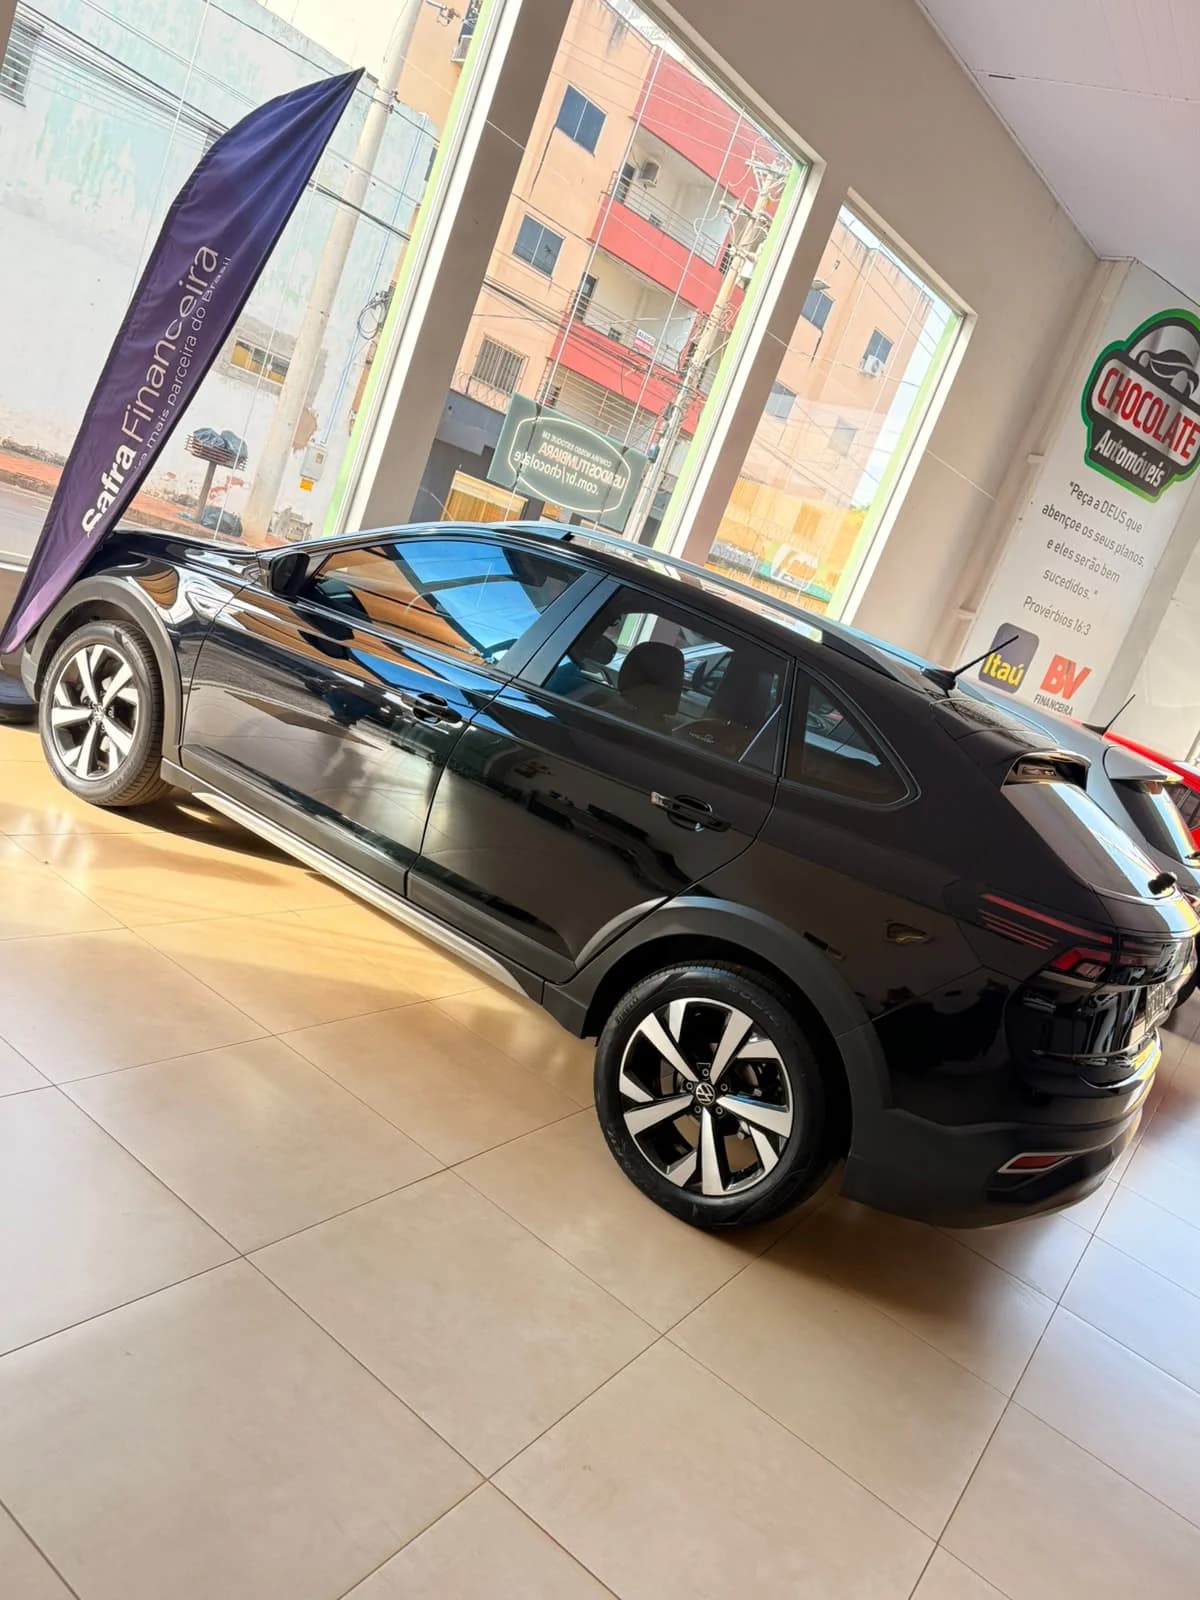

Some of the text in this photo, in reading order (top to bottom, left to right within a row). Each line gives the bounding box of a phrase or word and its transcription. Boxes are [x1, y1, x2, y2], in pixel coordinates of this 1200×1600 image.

[82, 246, 219, 537] Safra Financeira
[147, 408, 170, 449] mais
[167, 335, 197, 406] parceira
[191, 306, 207, 331] do
[1097, 367, 1200, 460] CHOCOLATE
[1094, 429, 1166, 488] Automóveis
[1041, 503, 1082, 533] abençoe
[1082, 526, 1096, 539] os
[1093, 531, 1116, 550] seus
[1093, 499, 1101, 511] a
[1100, 500, 1128, 525] DEUS
[1126, 517, 1143, 534] que
[1046, 538, 1121, 584] e eles serão bem
[1023, 595, 1093, 637] Provérbios 16:3
[982, 652, 1025, 687] Itaú
[1040, 654, 1092, 700] BV
[1034, 695, 1074, 715] FINANCEIRA
